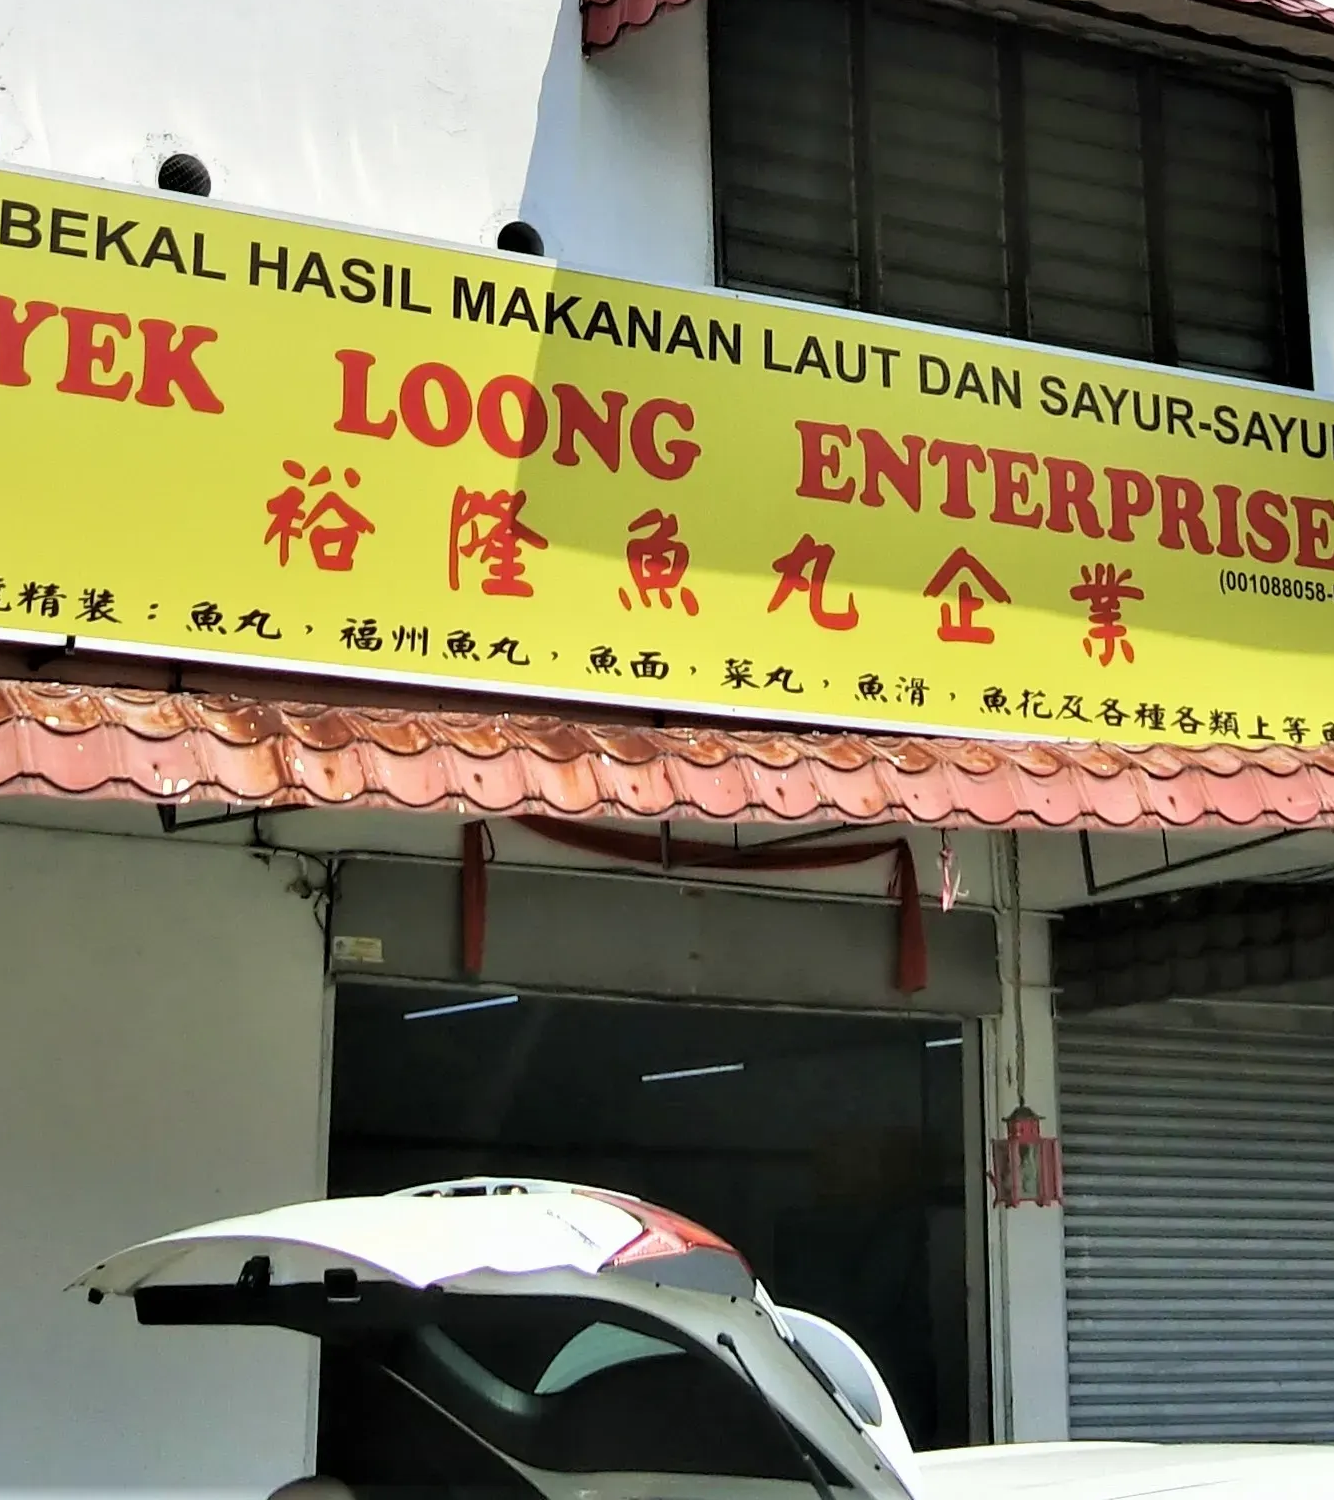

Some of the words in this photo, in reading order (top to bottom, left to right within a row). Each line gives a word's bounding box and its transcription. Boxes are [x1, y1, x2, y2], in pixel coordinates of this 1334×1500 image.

[249, 241, 432, 315] HASIL
[452, 275, 741, 365] MAKANAN
[763, 328, 901, 388] LAUT
[919, 354, 1022, 410] DAN
[334, 349, 701, 481] LOONG
[264, 459, 1145, 667] 裕隆魚丸企業
